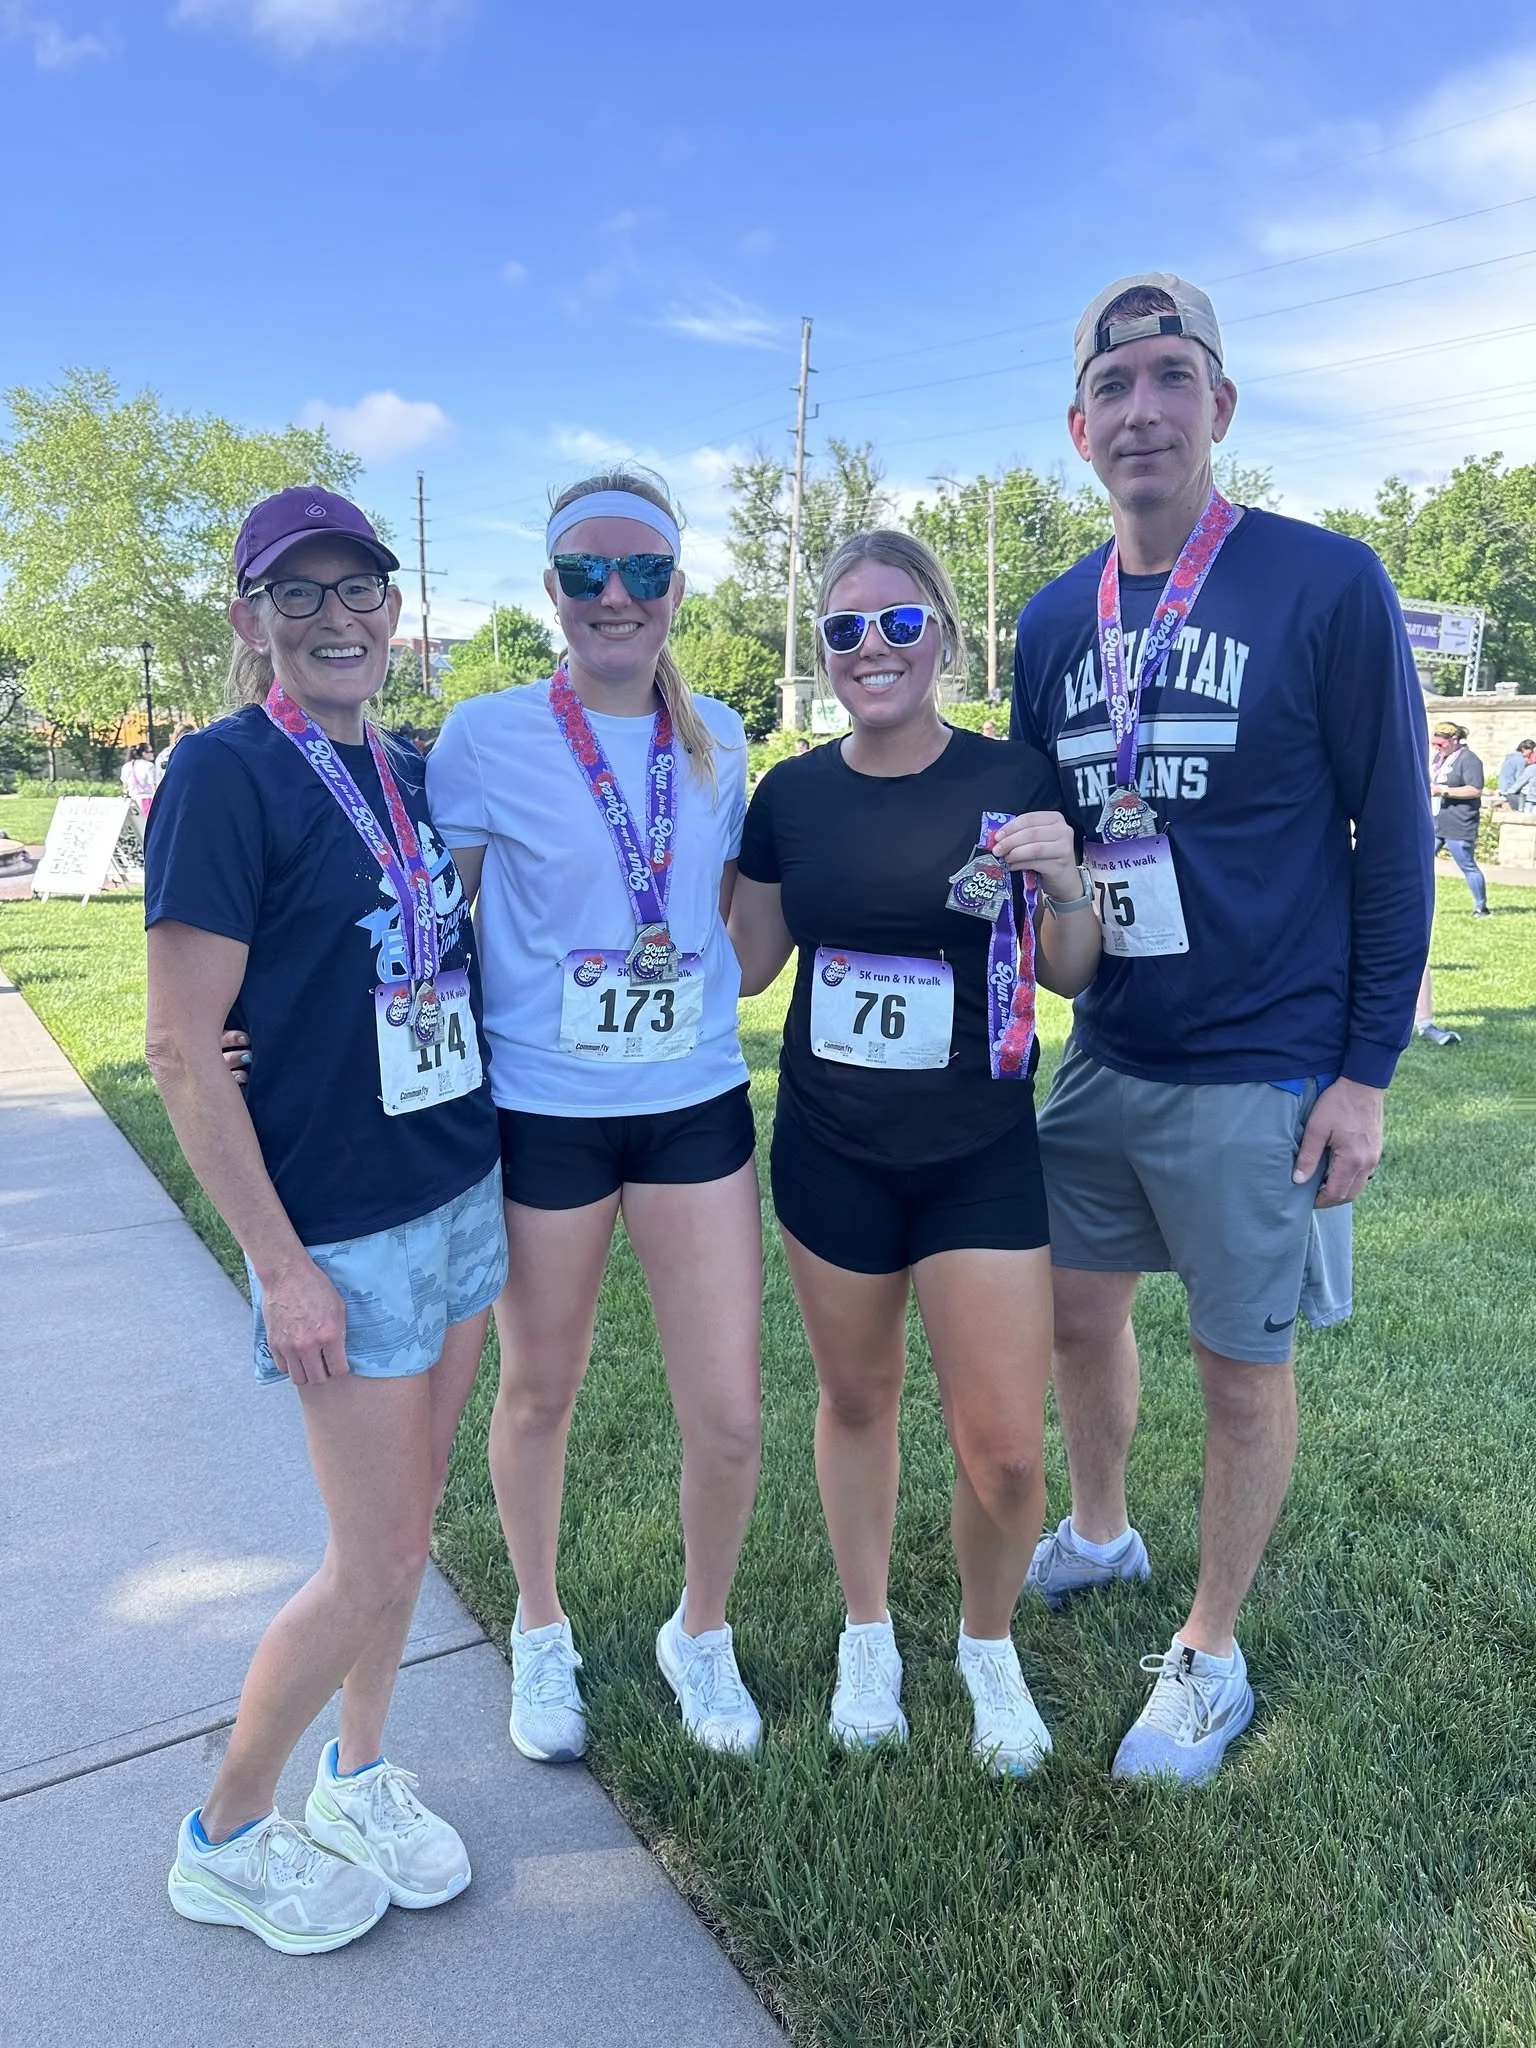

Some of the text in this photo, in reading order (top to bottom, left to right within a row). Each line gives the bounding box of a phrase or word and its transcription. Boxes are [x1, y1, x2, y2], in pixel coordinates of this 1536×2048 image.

[1102, 627, 1120, 668] Run
[1146, 607, 1178, 659] Roses
[1064, 626, 1250, 719] MAHTAN
[649, 753, 674, 790] Run
[1074, 756, 1209, 808] INANS
[306, 739, 341, 779] Run
[352, 805, 388, 855] Roses
[598, 781, 627, 826] Roses
[1113, 806, 1137, 820] Run
[649, 815, 674, 864] Roses
[1112, 819, 1141, 834] Roses
[628, 852, 651, 892] Run
[972, 871, 997, 887] Run
[1109, 861, 1116, 871] &
[1117, 859, 1131, 869] 1K
[1132, 854, 1157, 867] walk
[416, 877, 435, 931] Roses
[964, 882, 994, 899] Roses
[1094, 880, 1136, 927] 75
[640, 955, 668, 969] Roses
[644, 942, 667, 957] Run
[617, 968, 692, 977] 5K alk
[859, 970, 941, 986] 5K run & 1K walk
[990, 961, 1014, 1002] Run
[440, 991, 446, 1002] &
[446, 990, 456, 1000] 1K
[597, 988, 675, 1033] 173
[852, 990, 907, 1040] 76
